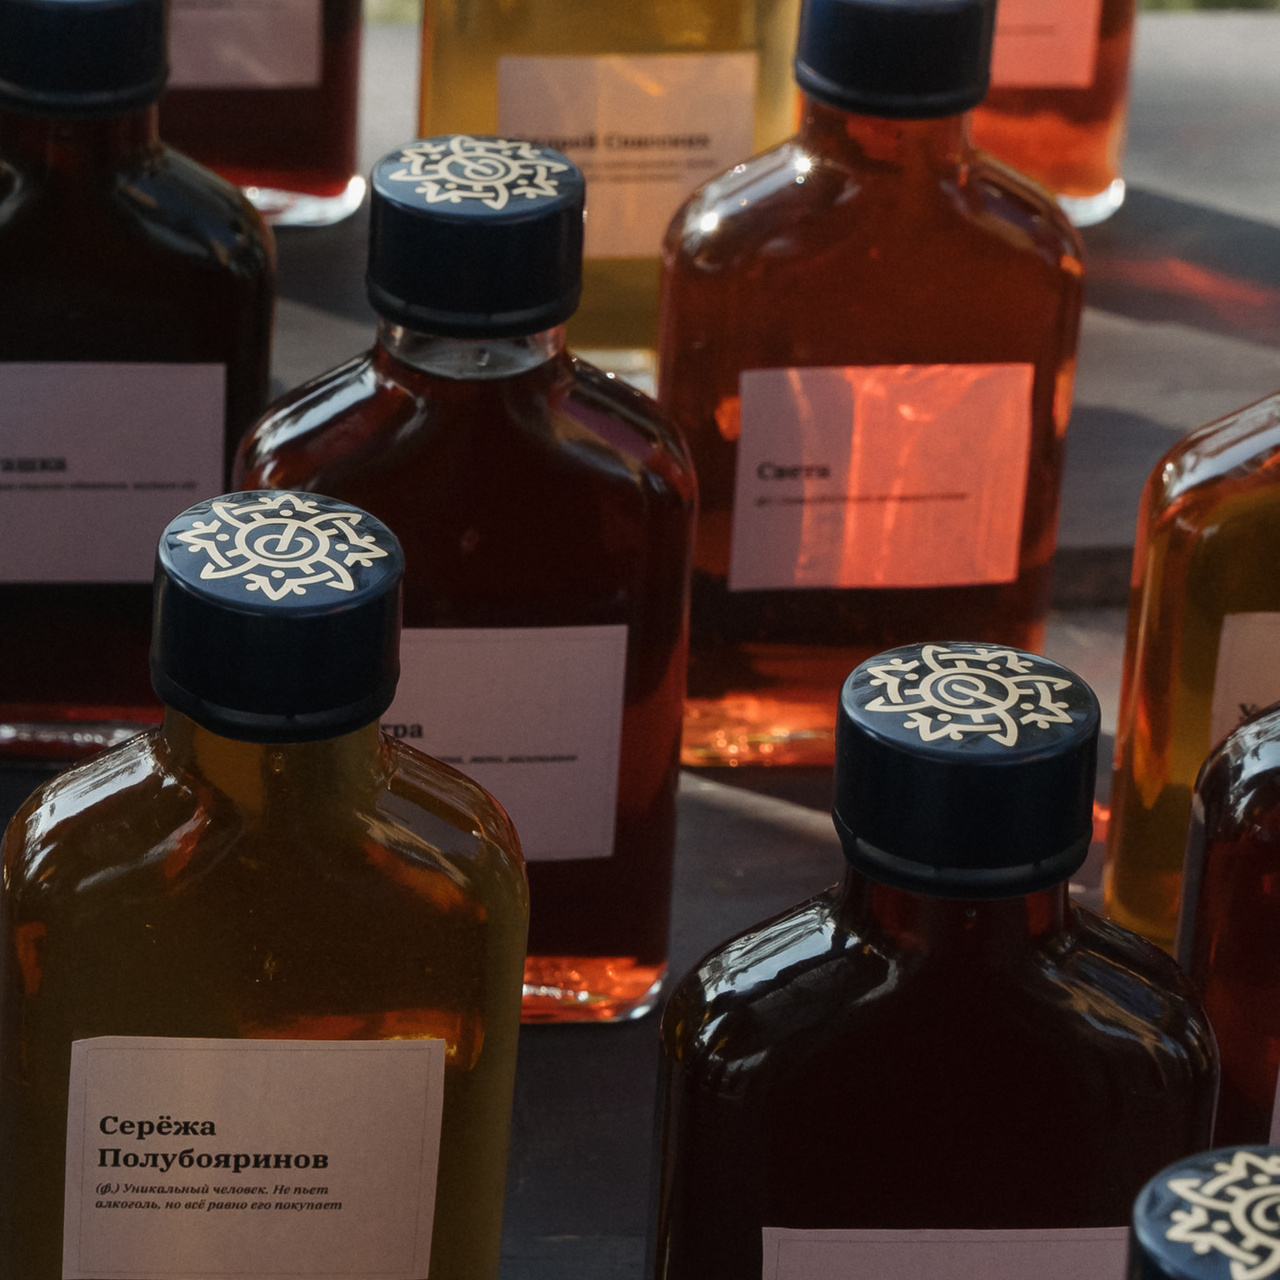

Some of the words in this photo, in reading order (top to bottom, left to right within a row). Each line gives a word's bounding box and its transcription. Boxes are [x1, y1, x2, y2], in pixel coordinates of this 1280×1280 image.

[756, 461, 833, 482] Света
[99, 1115, 217, 1141] Серёжа
[97, 1147, 329, 1174] Полубояринов
[95, 1182, 120, 1196] (ф.)
[122, 1183, 210, 1195] Уникальный
[212, 1186, 269, 1195] человек.
[272, 1184, 291, 1195] Не
[293, 1186, 329, 1195] пьет
[164, 1201, 182, 1211] но
[183, 1199, 206, 1211] всё
[206, 1200, 248, 1213] равно
[250, 1201, 272, 1211] его
[274, 1201, 343, 1213] покупает
